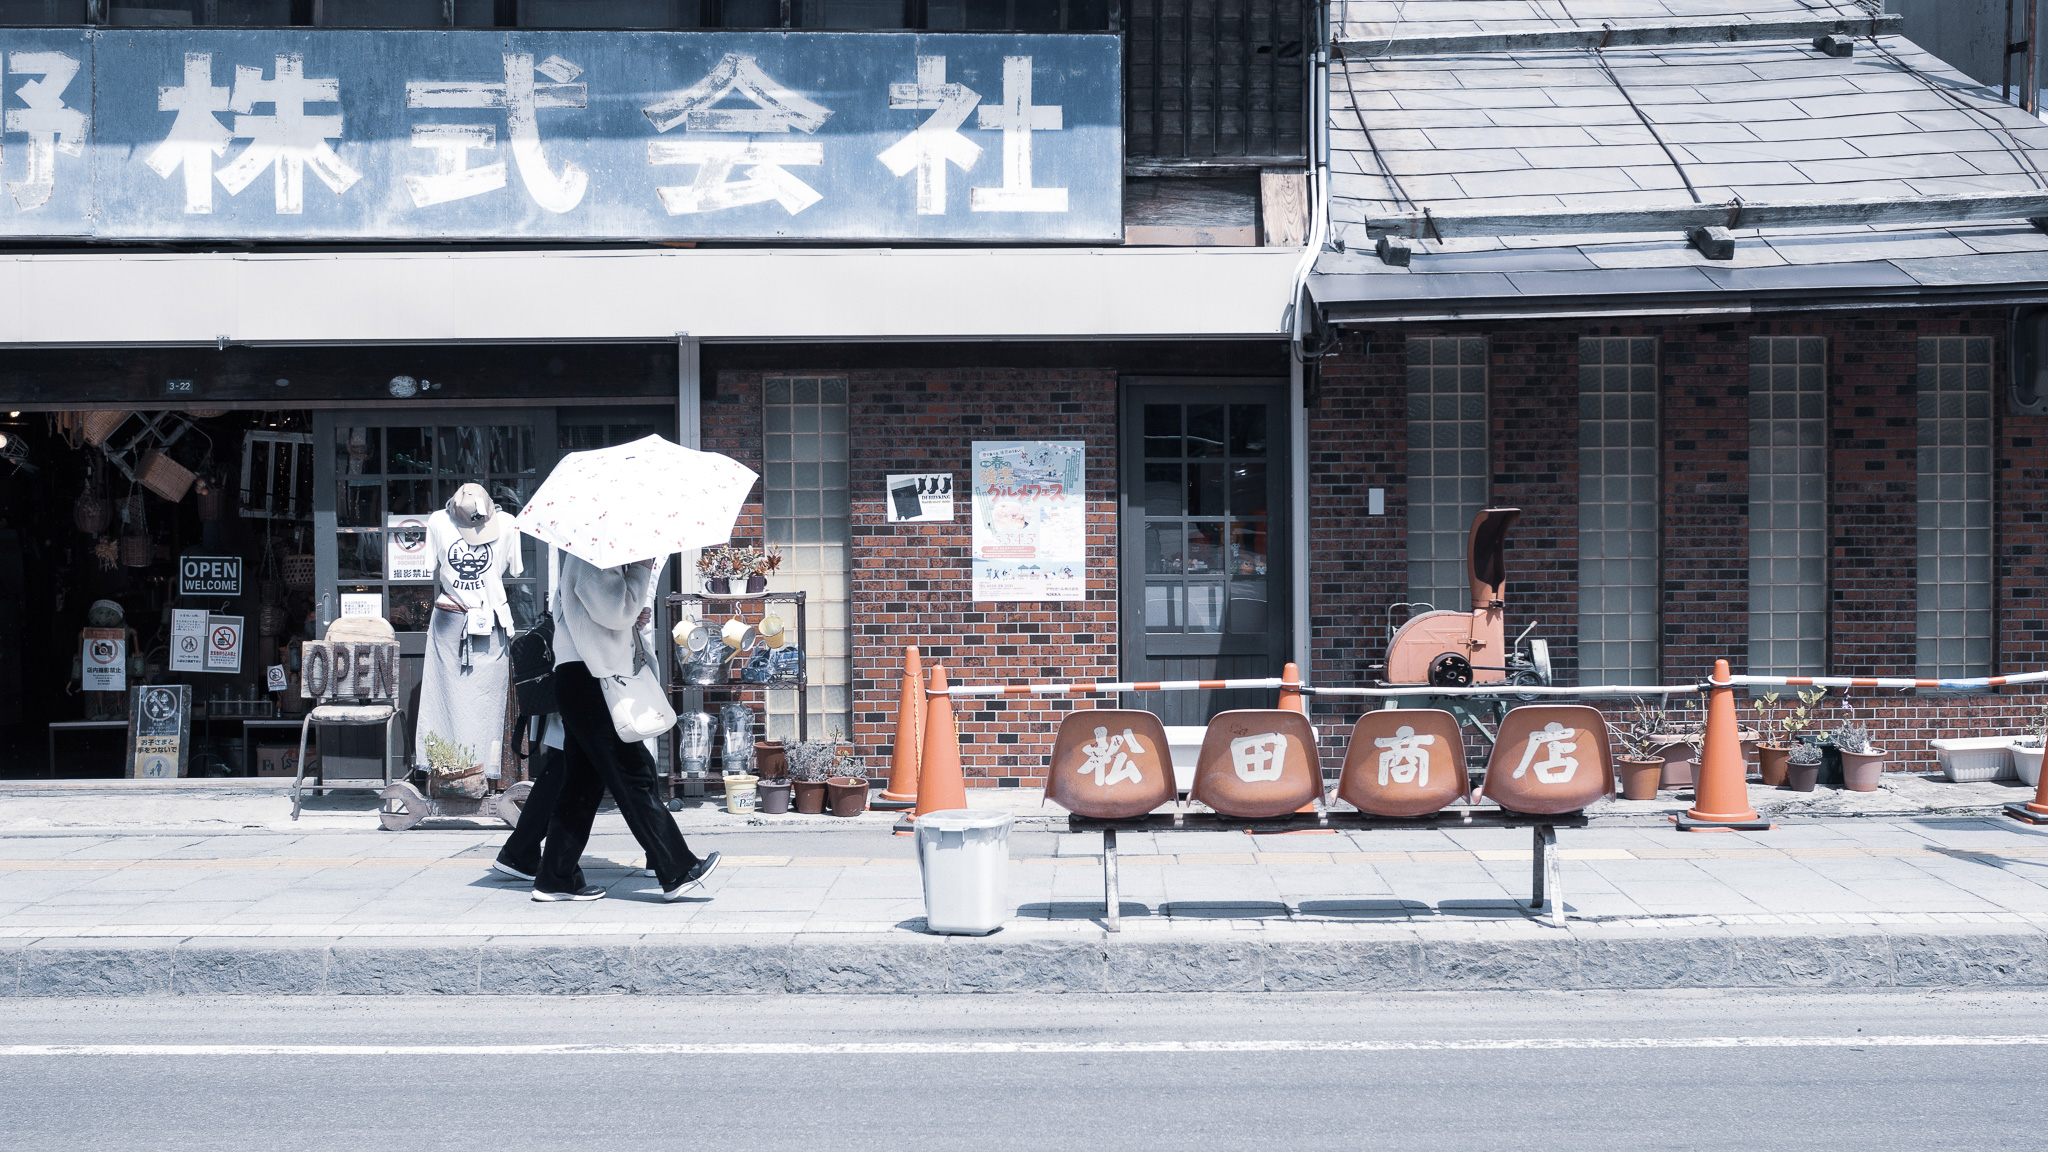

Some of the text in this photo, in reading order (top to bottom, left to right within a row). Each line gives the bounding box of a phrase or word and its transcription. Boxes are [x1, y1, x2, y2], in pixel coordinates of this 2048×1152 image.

[169, 382, 191, 391] 3-22
[987, 483, 1065, 503] グルメフェス
[184, 561, 237, 578] OPEN
[393, 568, 431, 578] 撮影禁止
[184, 579, 237, 591] WELCOME
[307, 644, 395, 696] OPEN
[140, 738, 174, 747] お子さまと
[137, 746, 178, 755] 手をつないで
